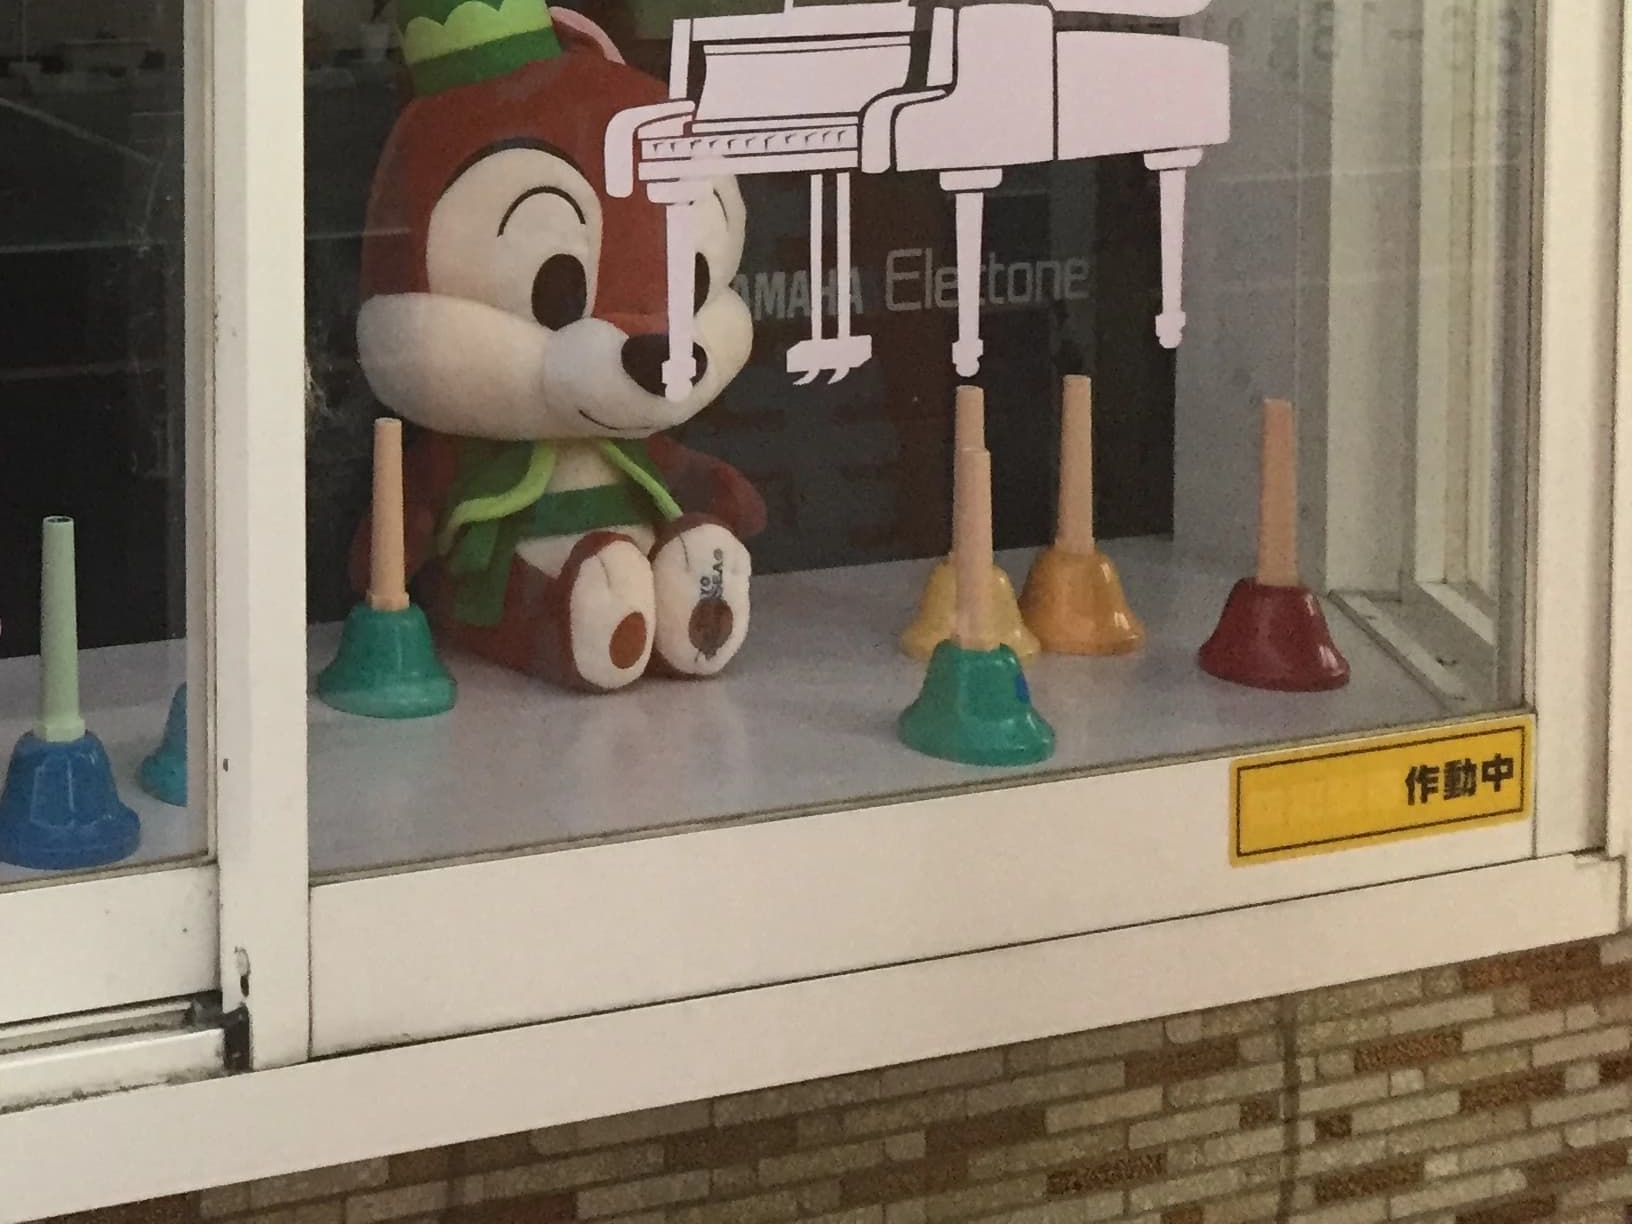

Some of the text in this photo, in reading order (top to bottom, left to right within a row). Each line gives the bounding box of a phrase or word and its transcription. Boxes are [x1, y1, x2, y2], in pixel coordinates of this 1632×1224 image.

[885, 247, 1091, 313] Eletone
[1404, 752, 1514, 806] 作動中
